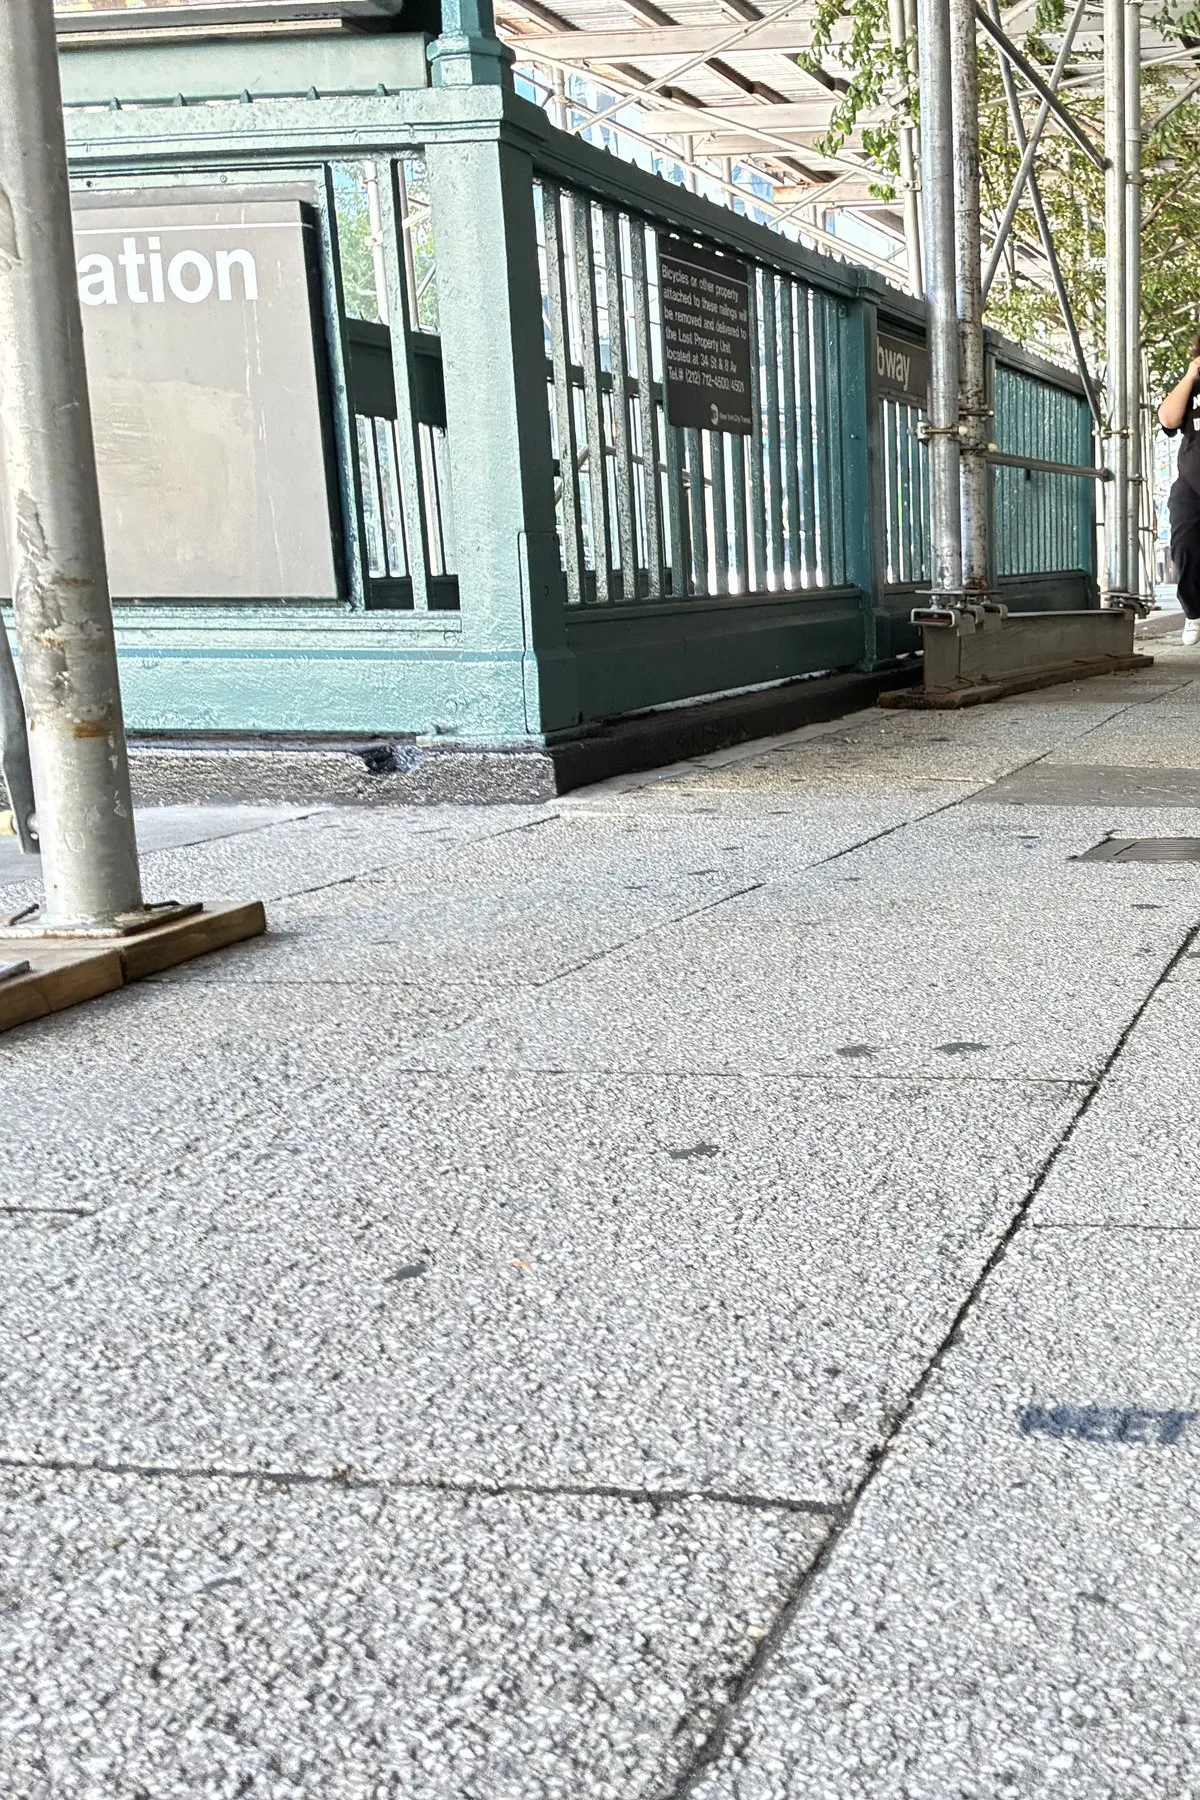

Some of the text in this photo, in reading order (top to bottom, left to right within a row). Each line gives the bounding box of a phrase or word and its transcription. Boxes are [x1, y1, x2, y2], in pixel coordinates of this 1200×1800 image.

[77, 236, 259, 306] ation
[662, 264, 738, 303] Bicycles or other property
[663, 286, 747, 322] attached to these railings will
[664, 305, 747, 340] be removed and delivered to
[665, 326, 731, 354] the Lost Property Unit
[666, 346, 691, 363] located
[692, 353, 699, 365] at
[700, 353, 709, 366] 34
[710, 355, 718, 369] St
[719, 358, 724, 371] &
[725, 359, 729, 372] 8
[876, 336, 911, 392] bway
[685, 369, 701, 386] (212)
[1020, 1404, 1197, 1446] MEET
